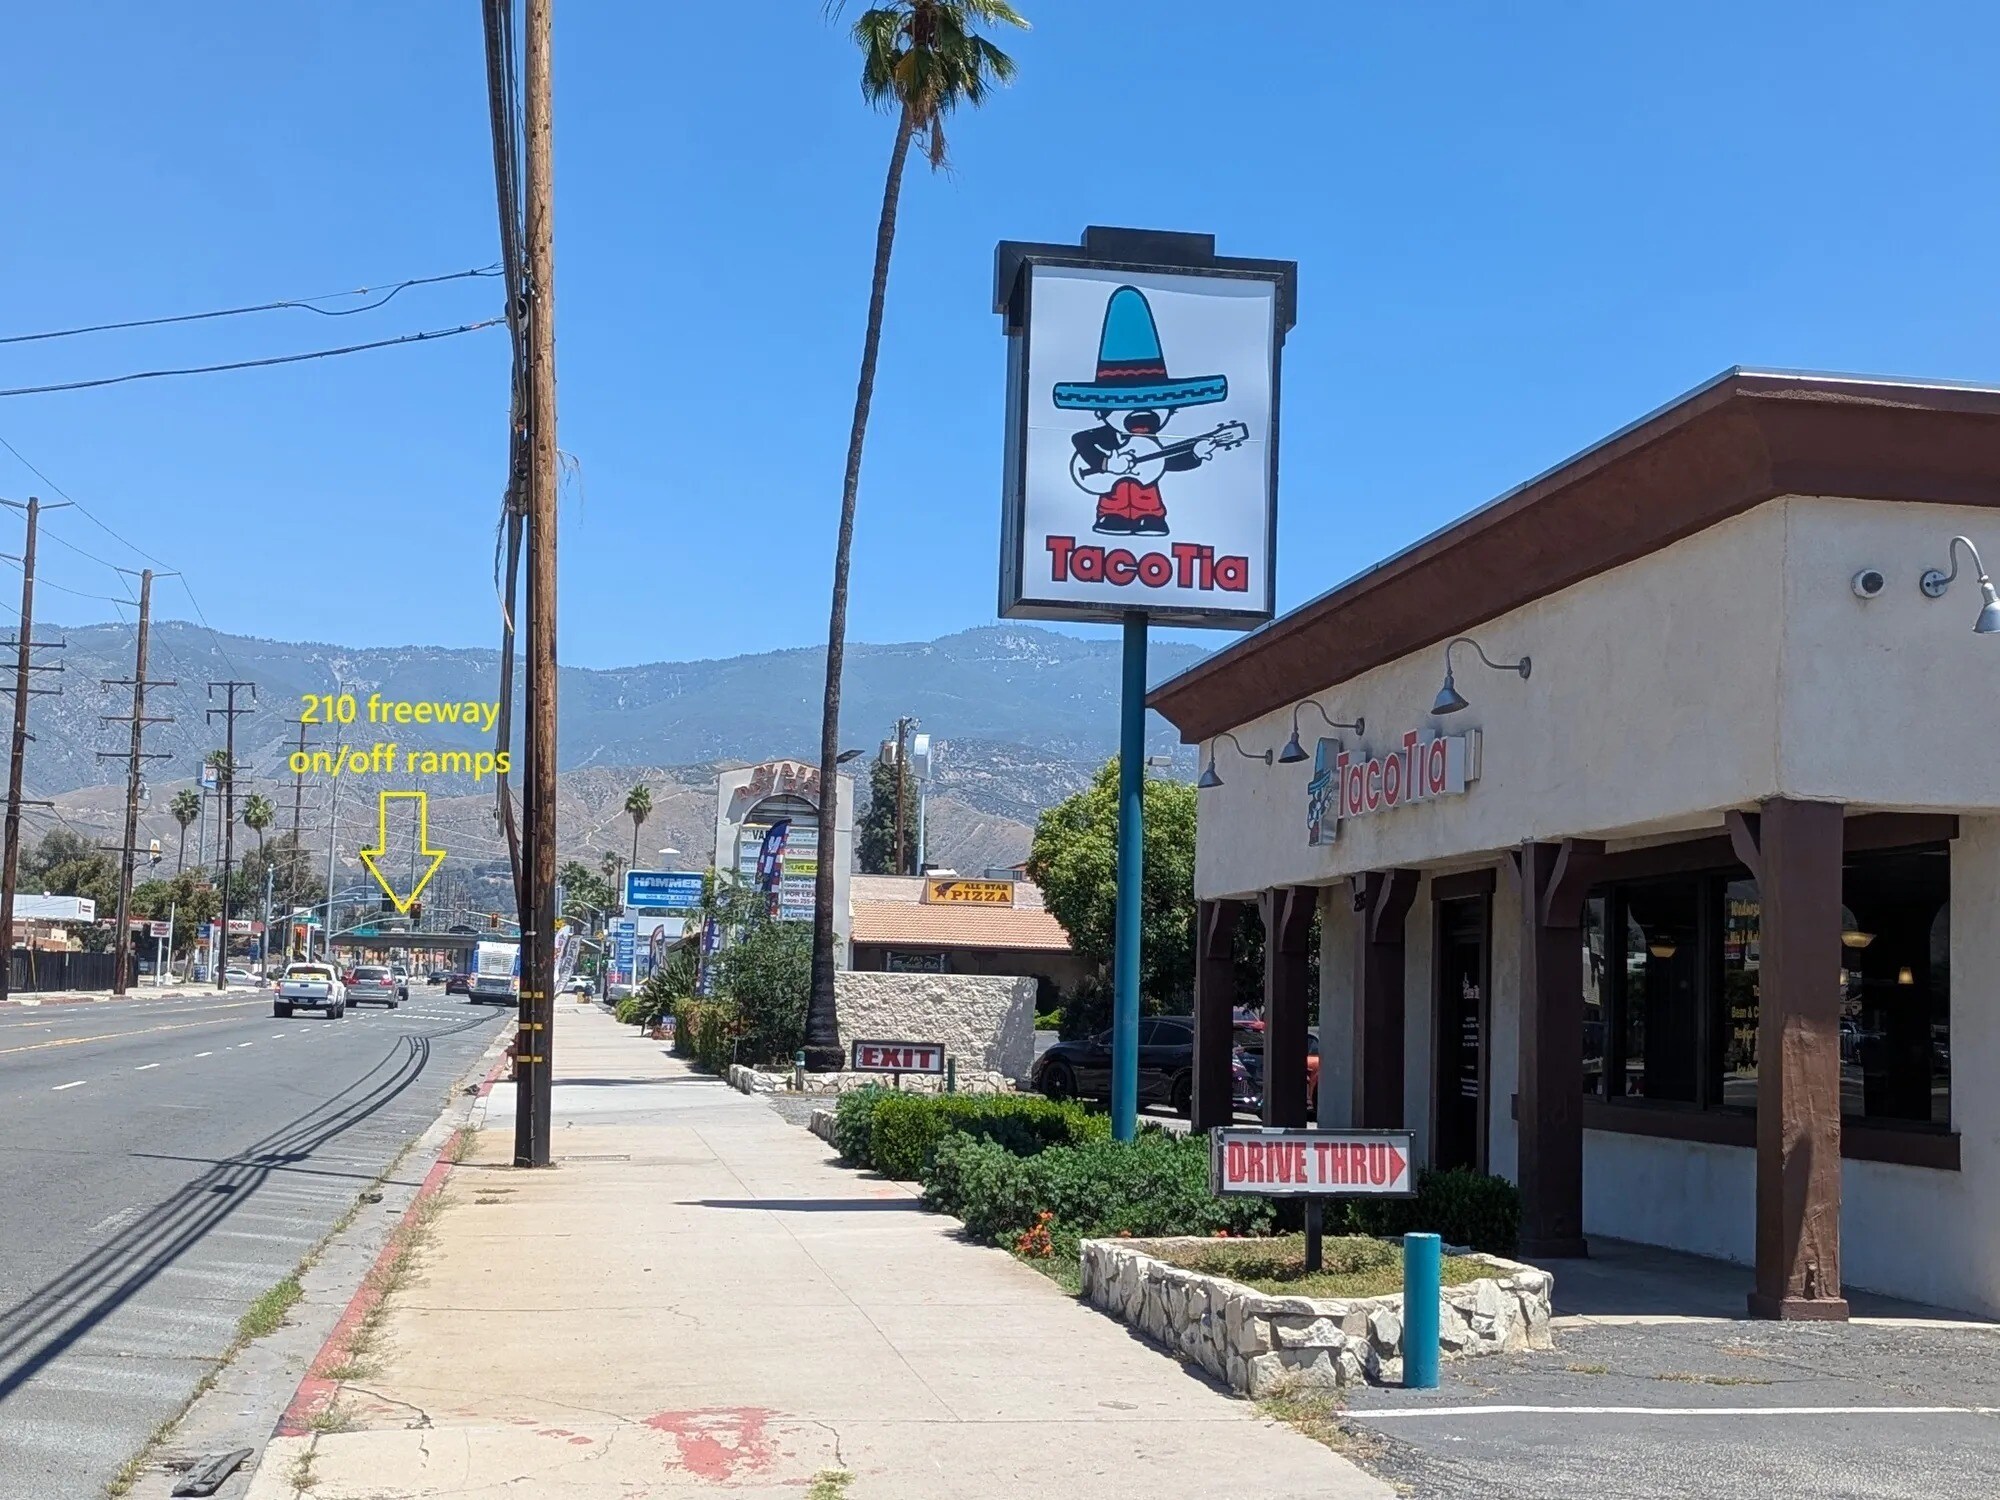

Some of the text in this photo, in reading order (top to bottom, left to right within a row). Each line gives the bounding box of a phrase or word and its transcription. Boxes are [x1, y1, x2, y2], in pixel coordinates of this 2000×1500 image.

[633, 876, 702, 889] HAMMER
[984, 883, 1009, 891] STAR
[950, 889, 1010, 902] PIZZA
[862, 1046, 936, 1069] EXIT
[1227, 1140, 1386, 1185] DRIVE THRU
